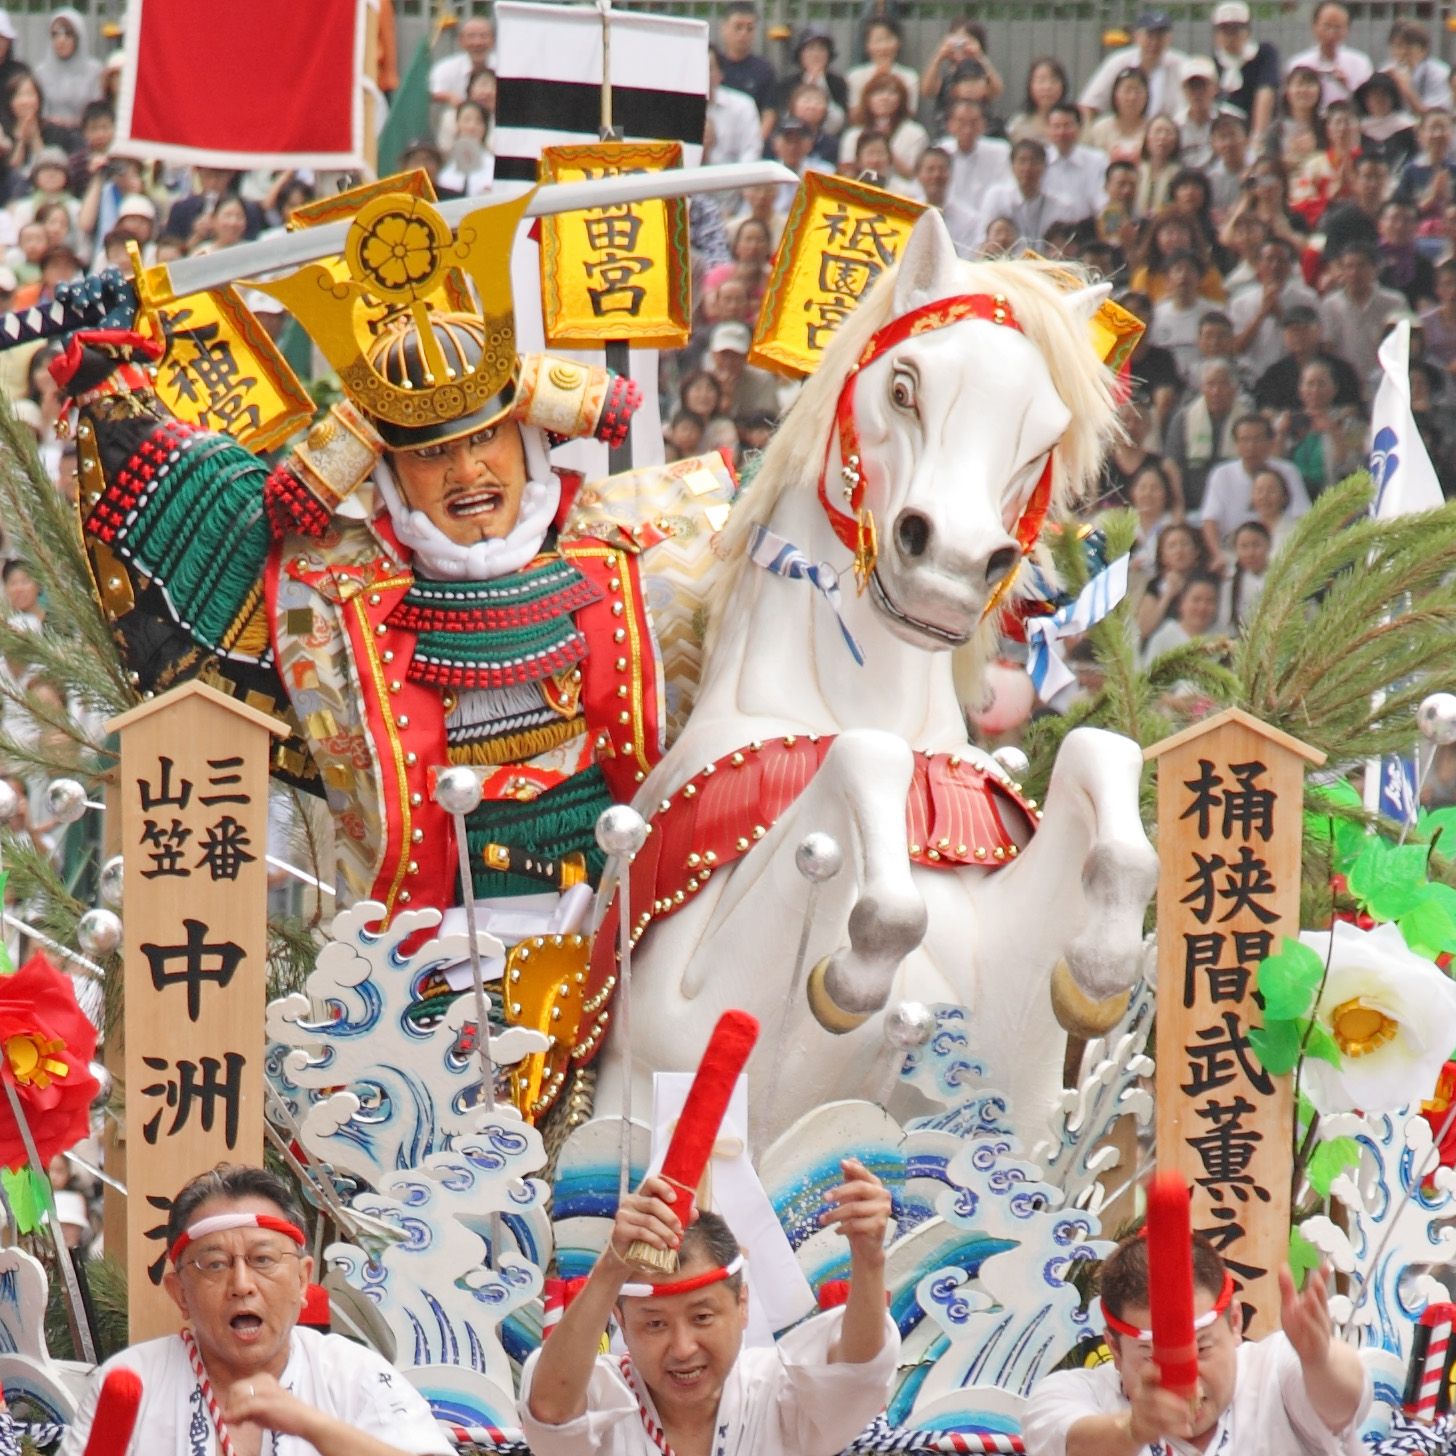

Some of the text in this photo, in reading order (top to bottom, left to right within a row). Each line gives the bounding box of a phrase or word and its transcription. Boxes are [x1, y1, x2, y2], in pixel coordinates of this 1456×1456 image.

[140, 919, 248, 1282] 中洲
[1179, 759, 1282, 1341] 桶狭間武薫之
